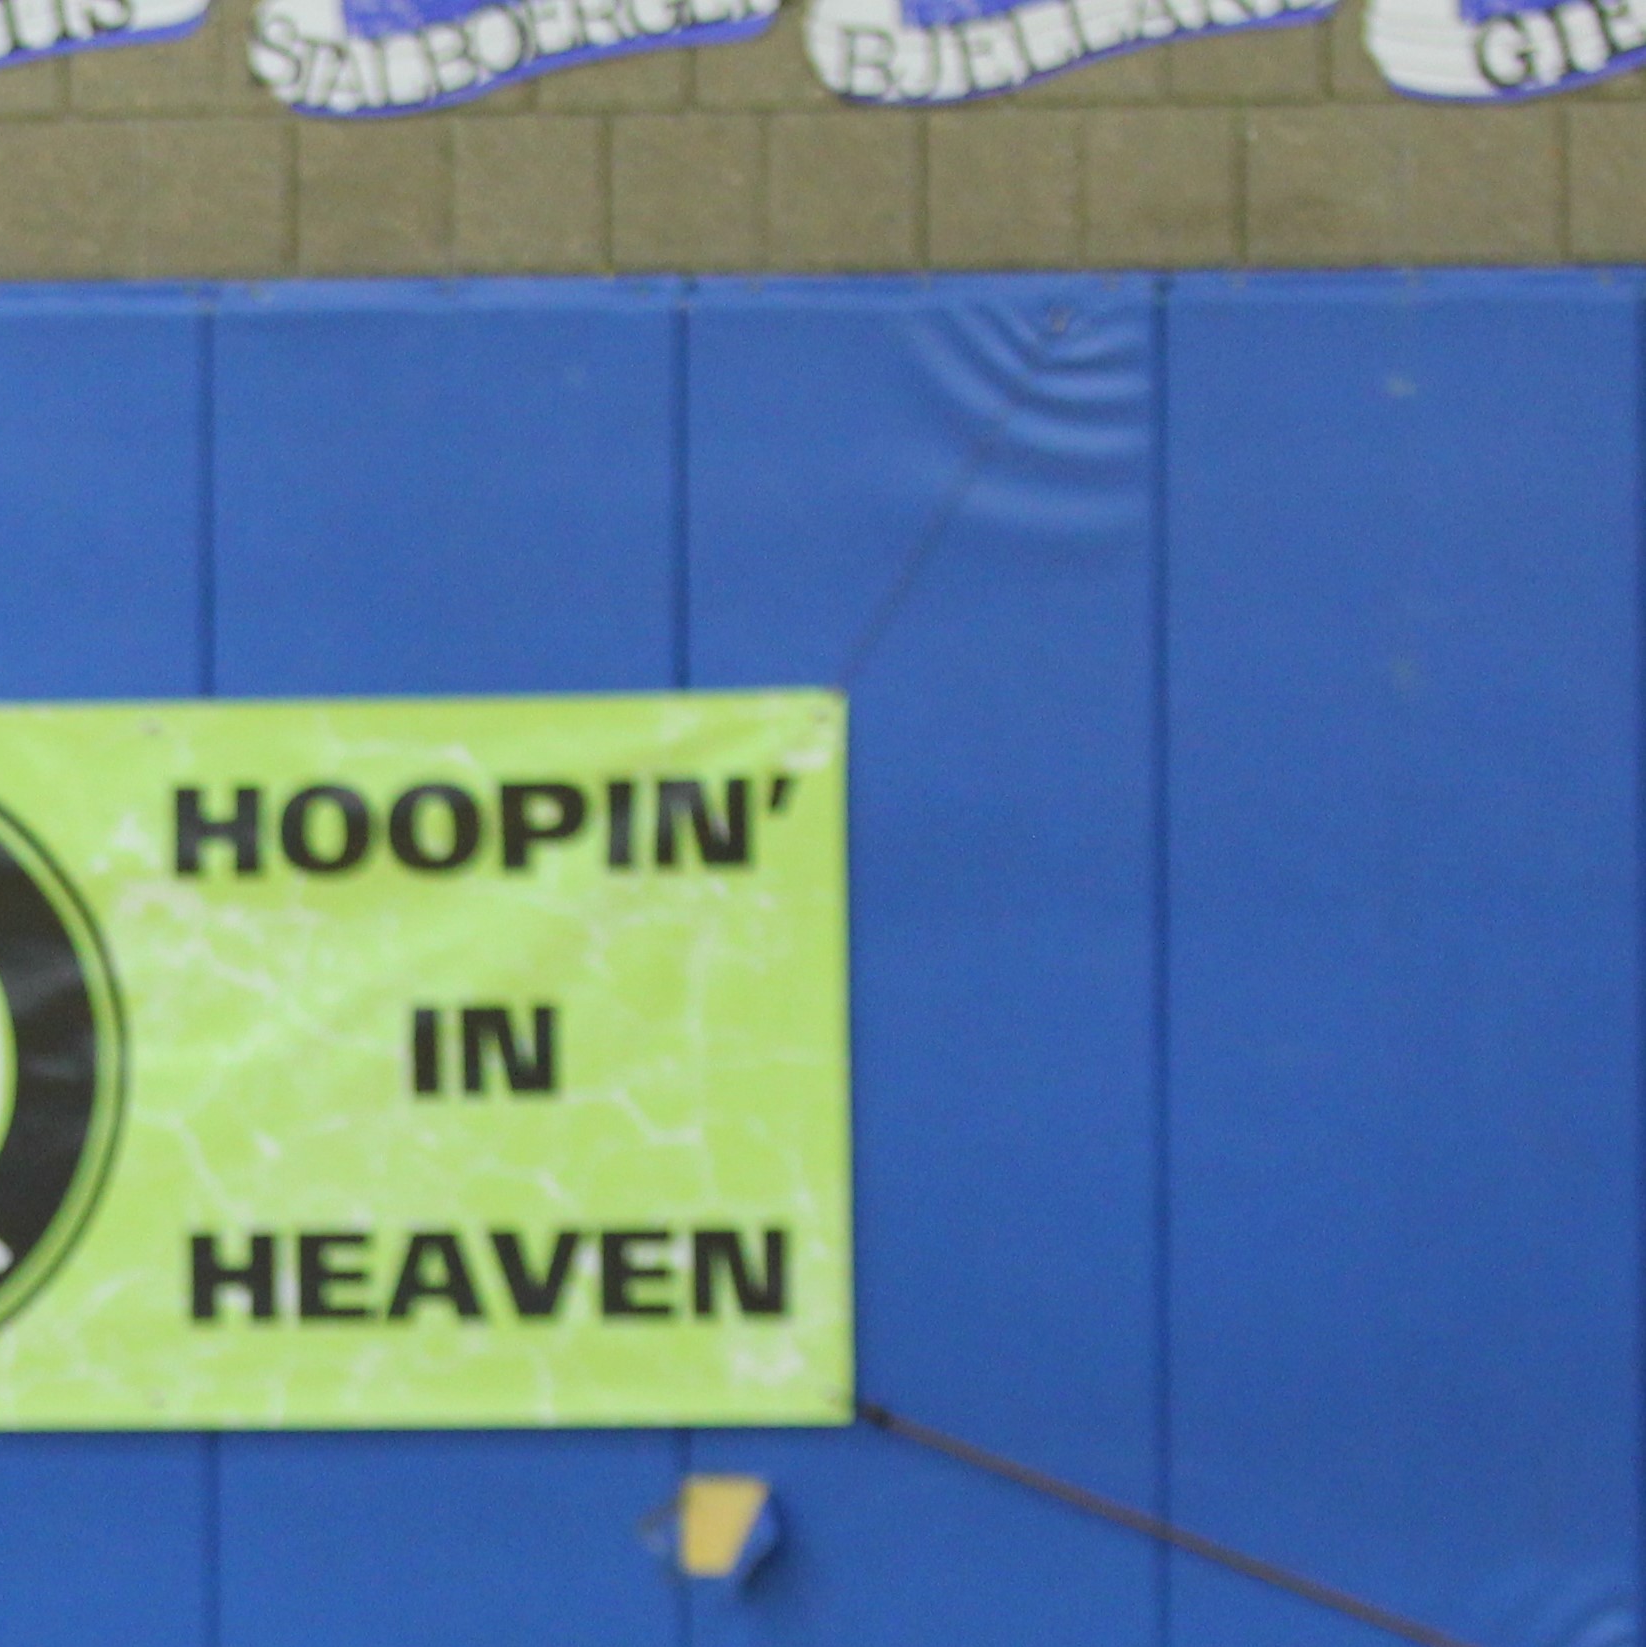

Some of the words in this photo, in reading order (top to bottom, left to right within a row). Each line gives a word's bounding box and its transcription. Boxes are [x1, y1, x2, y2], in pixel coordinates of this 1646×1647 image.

[171, 776, 797, 877] HOOPIN'
[410, 1005, 560, 1097] IN
[187, 1228, 789, 1324] HEAVEN
